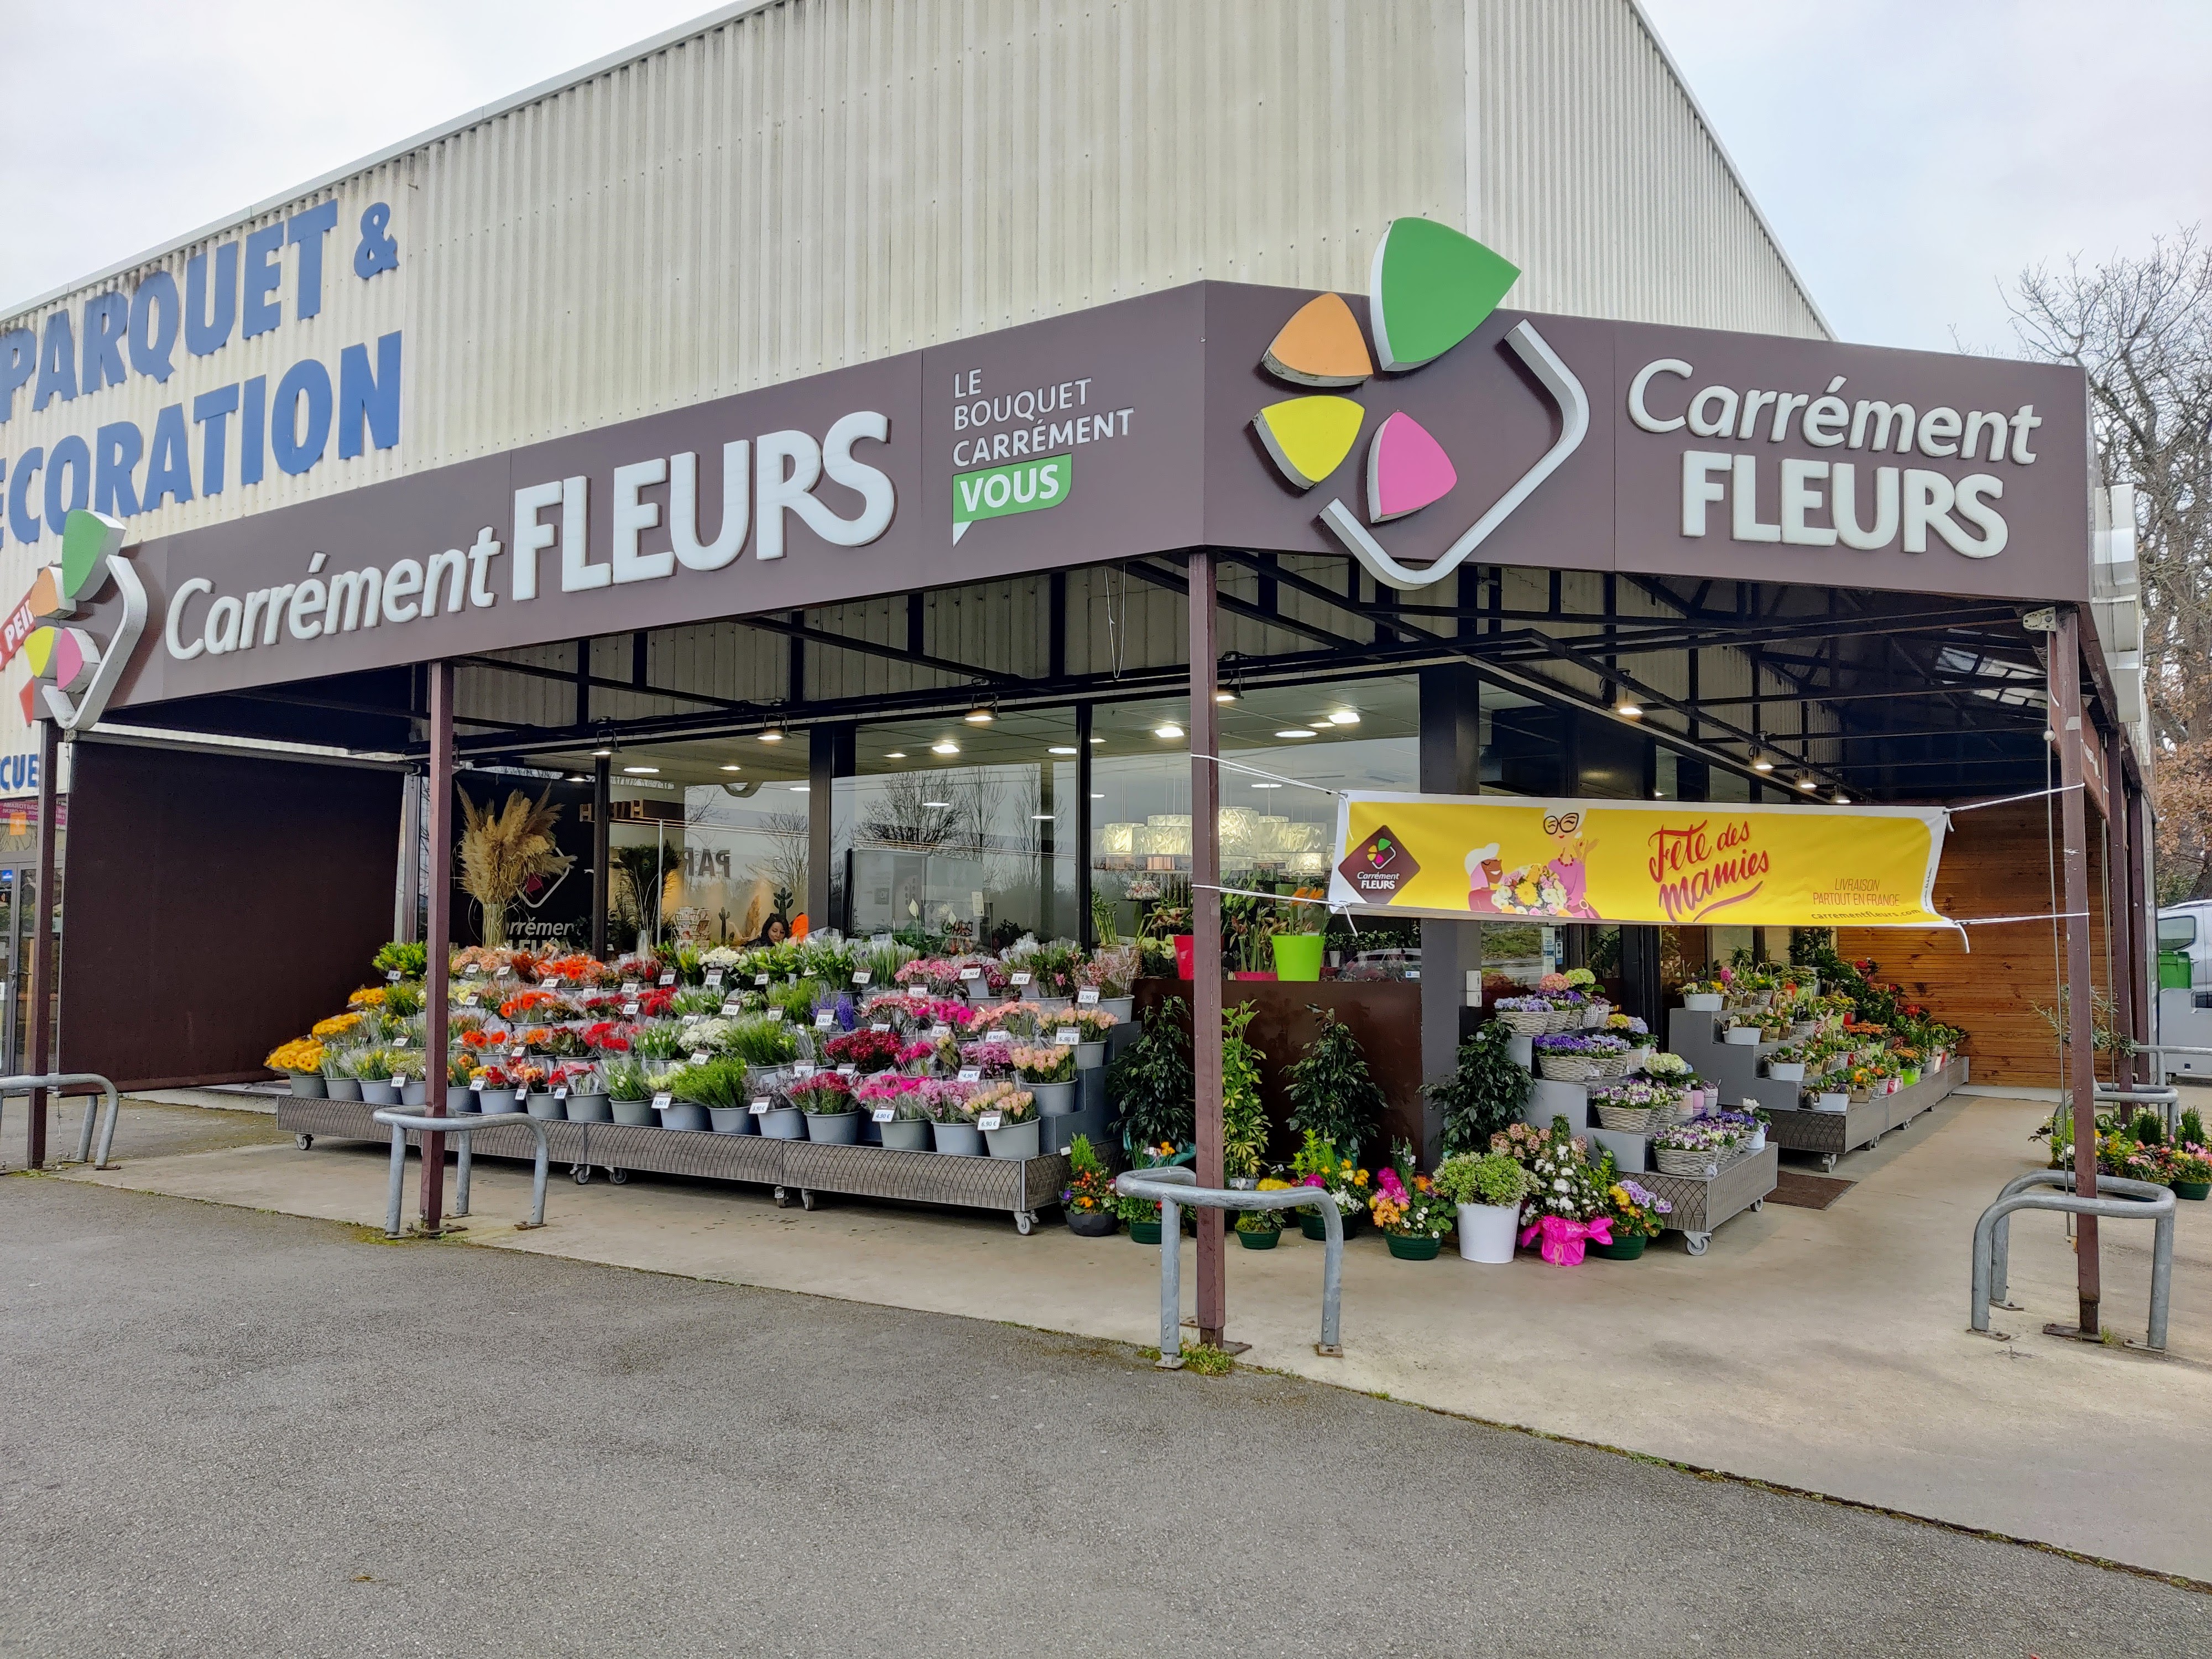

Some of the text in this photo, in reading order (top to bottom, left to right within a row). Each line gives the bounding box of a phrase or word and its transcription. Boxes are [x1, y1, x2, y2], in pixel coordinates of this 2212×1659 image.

[353, 202, 400, 279] &
[953, 377, 1092, 431] BOUQUET
[954, 368, 982, 399] LE
[952, 407, 1135, 467] CARRÉMENT
[1627, 358, 2043, 465] Carrément
[0, 330, 402, 548] CORATION
[959, 464, 1059, 512] VOUS
[1681, 450, 2008, 559] FLEURS
[165, 410, 898, 660] Carrément FLEURS
[1717, 820, 1750, 851] des
[1357, 871, 1400, 880] Carrément
[1360, 880, 1395, 890] FLEURS
[1658, 848, 1769, 922] mamies
[1813, 892, 1900, 906] PARTOUT EN FRANCE
[1835, 878, 1880, 891] LIVRAISON
[1811, 909, 1921, 920] carrementfleurs.com
